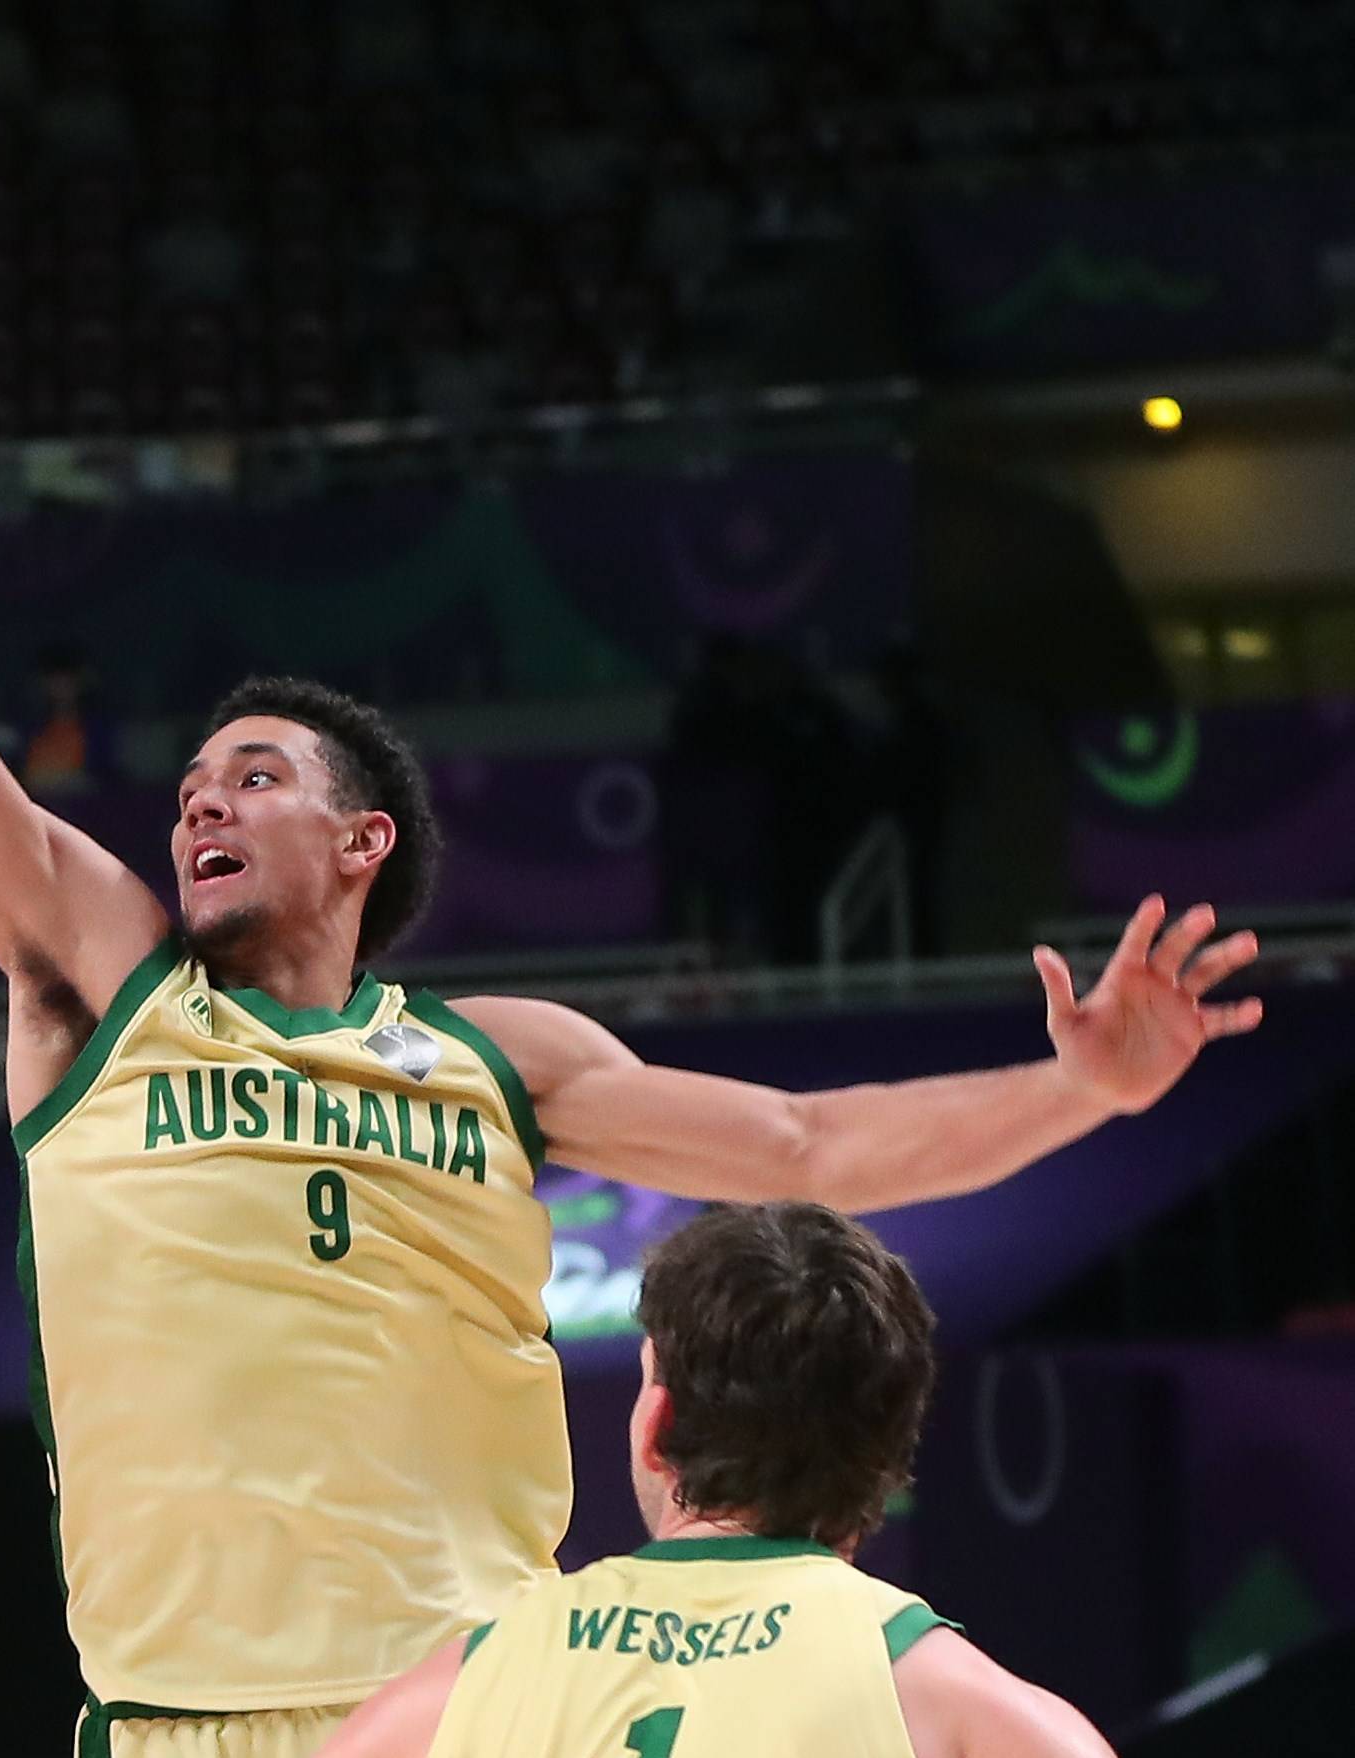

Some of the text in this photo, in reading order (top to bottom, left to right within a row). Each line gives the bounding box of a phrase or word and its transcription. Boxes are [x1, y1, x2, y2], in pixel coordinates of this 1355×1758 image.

[144, 1067, 487, 1185] AUSTRALIA
[305, 1168, 352, 1262] 9
[567, 1602, 791, 1666] WESSELS
